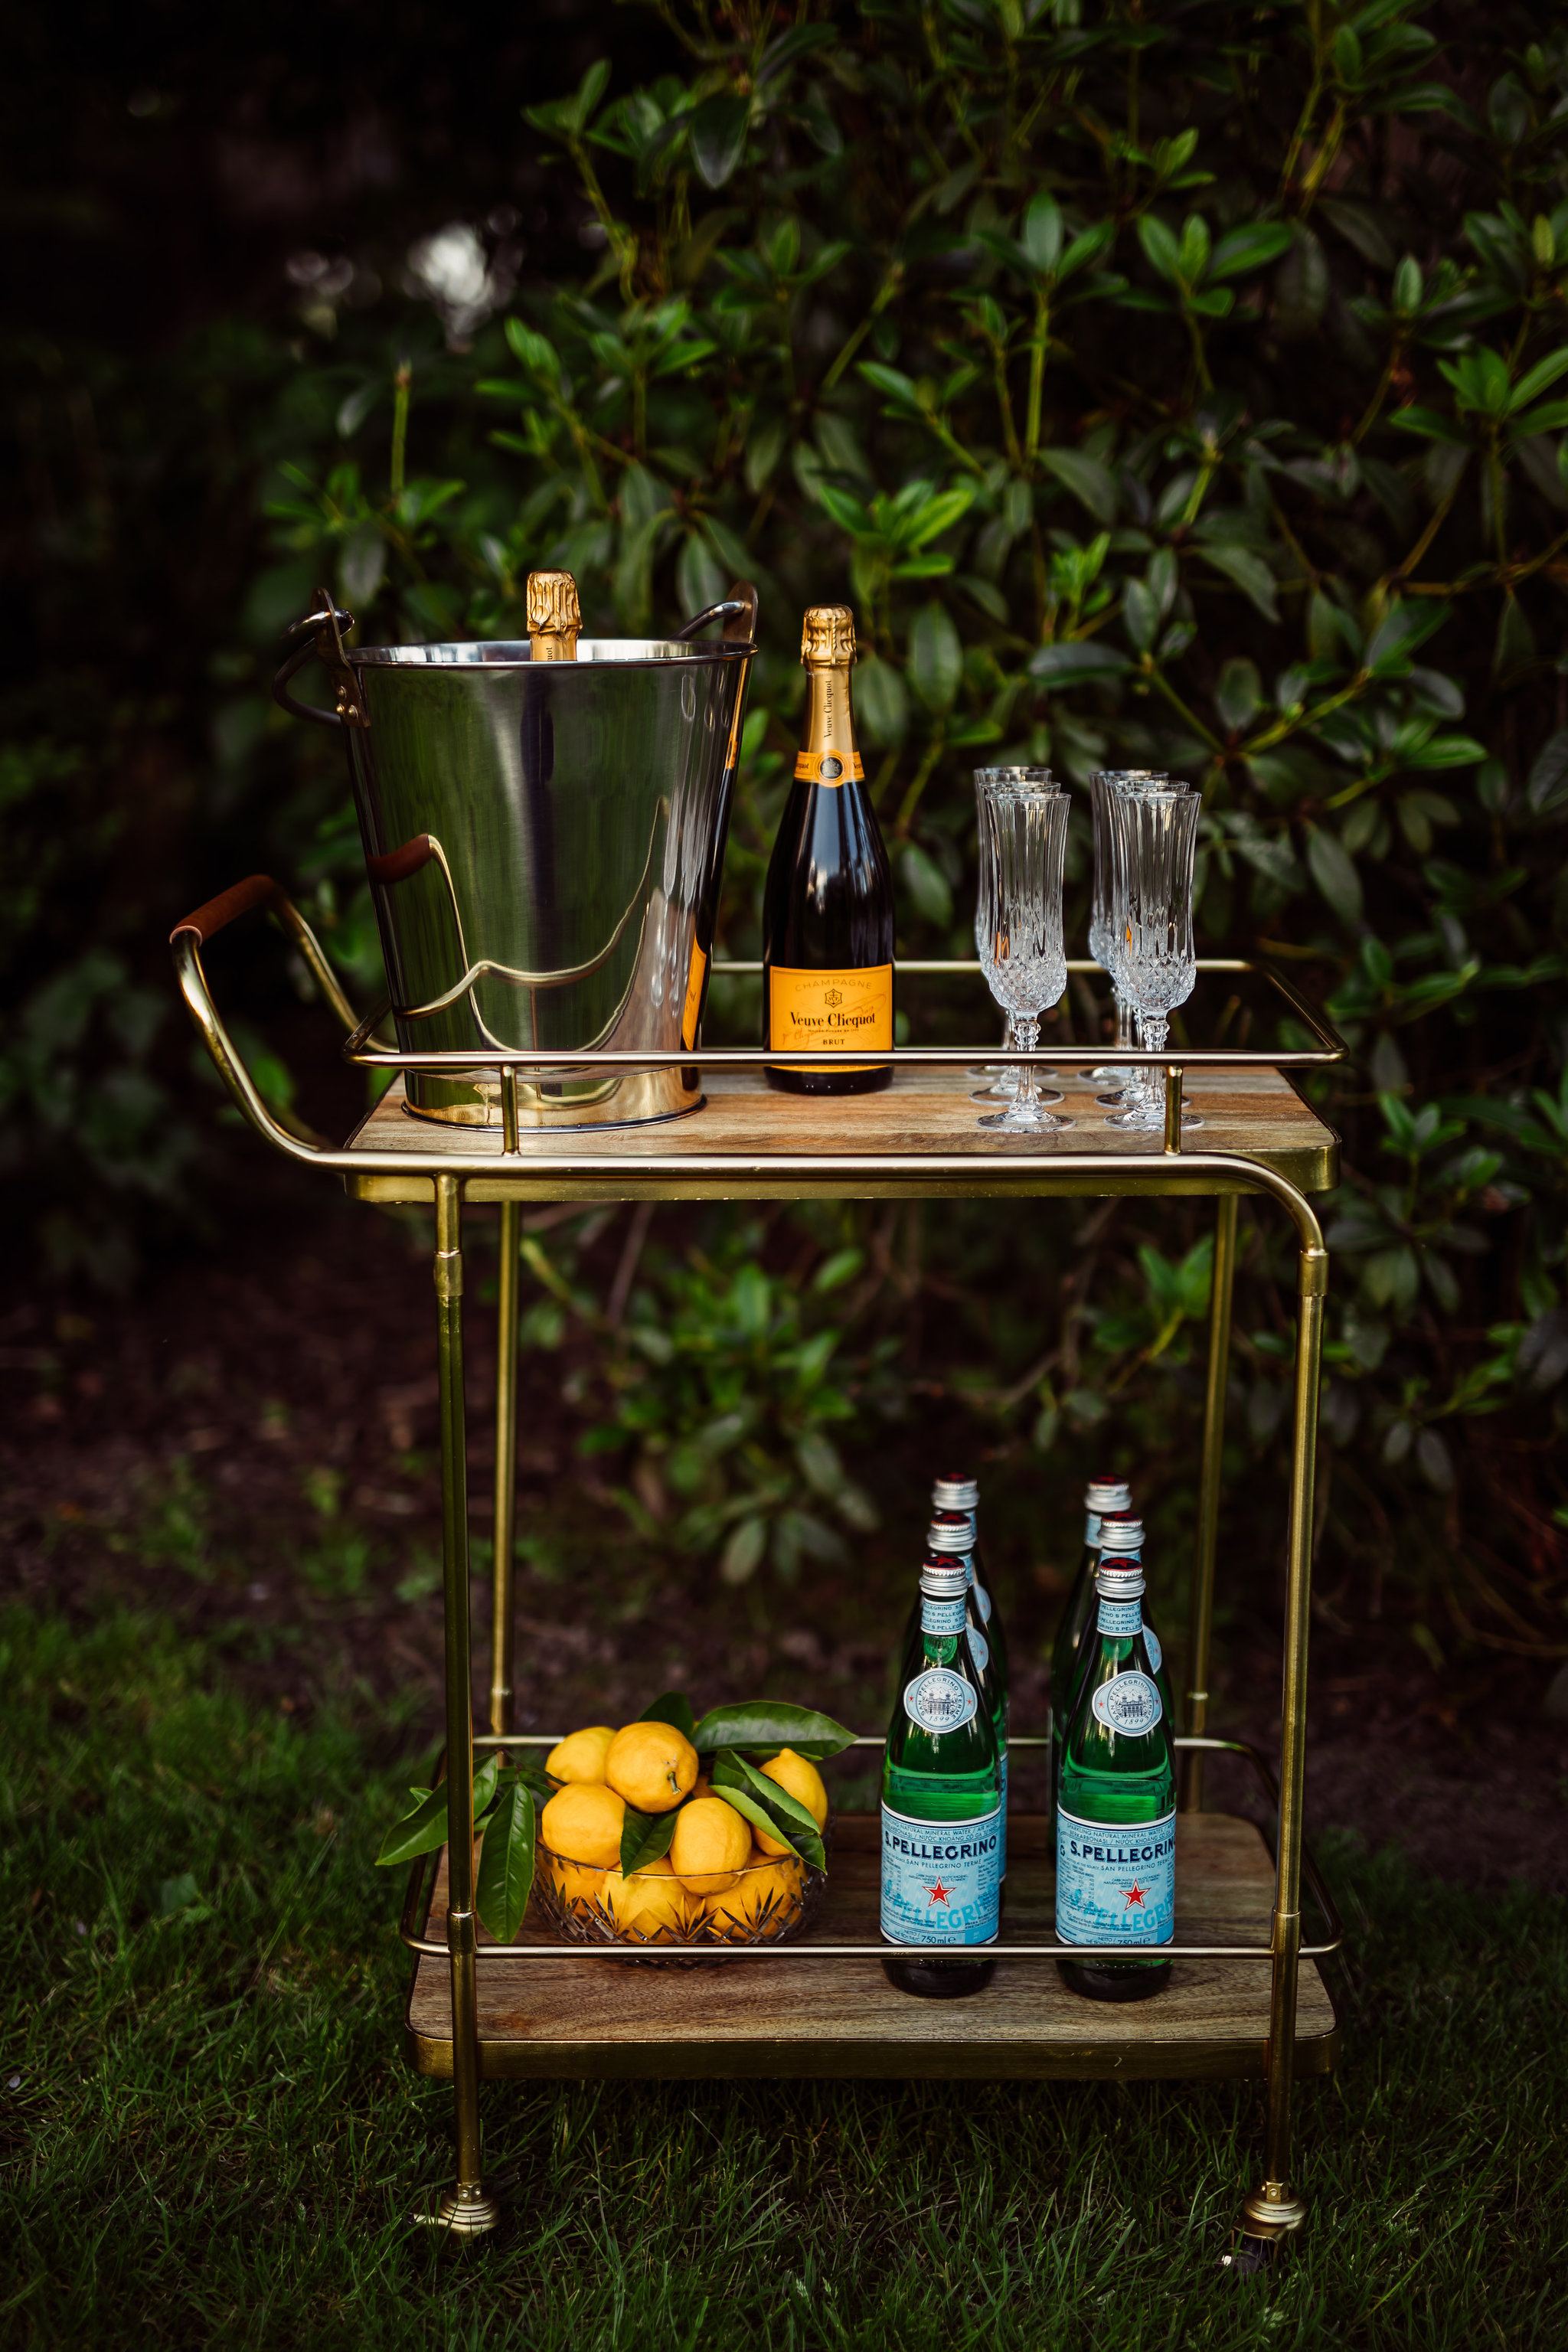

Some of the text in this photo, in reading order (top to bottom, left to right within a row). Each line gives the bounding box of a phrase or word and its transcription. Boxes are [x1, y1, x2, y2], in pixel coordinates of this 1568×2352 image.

[824, 681, 834, 738] Veuve Clicquot
[795, 978, 872, 992] CHAMPAGNE
[790, 1011, 876, 1028] Veuve Clicquot
[919, 1677, 959, 1696] PELLEGRINO
[951, 1694, 962, 1719] TERME
[1110, 1679, 1148, 1700] PELLEGRINO
[1110, 1705, 1120, 1720] SAN
[886, 1830, 997, 1860] S.PELLEGRINO
[1119, 1863, 1155, 1872] PELLEGRINO
[921, 1936, 936, 1944] 750
